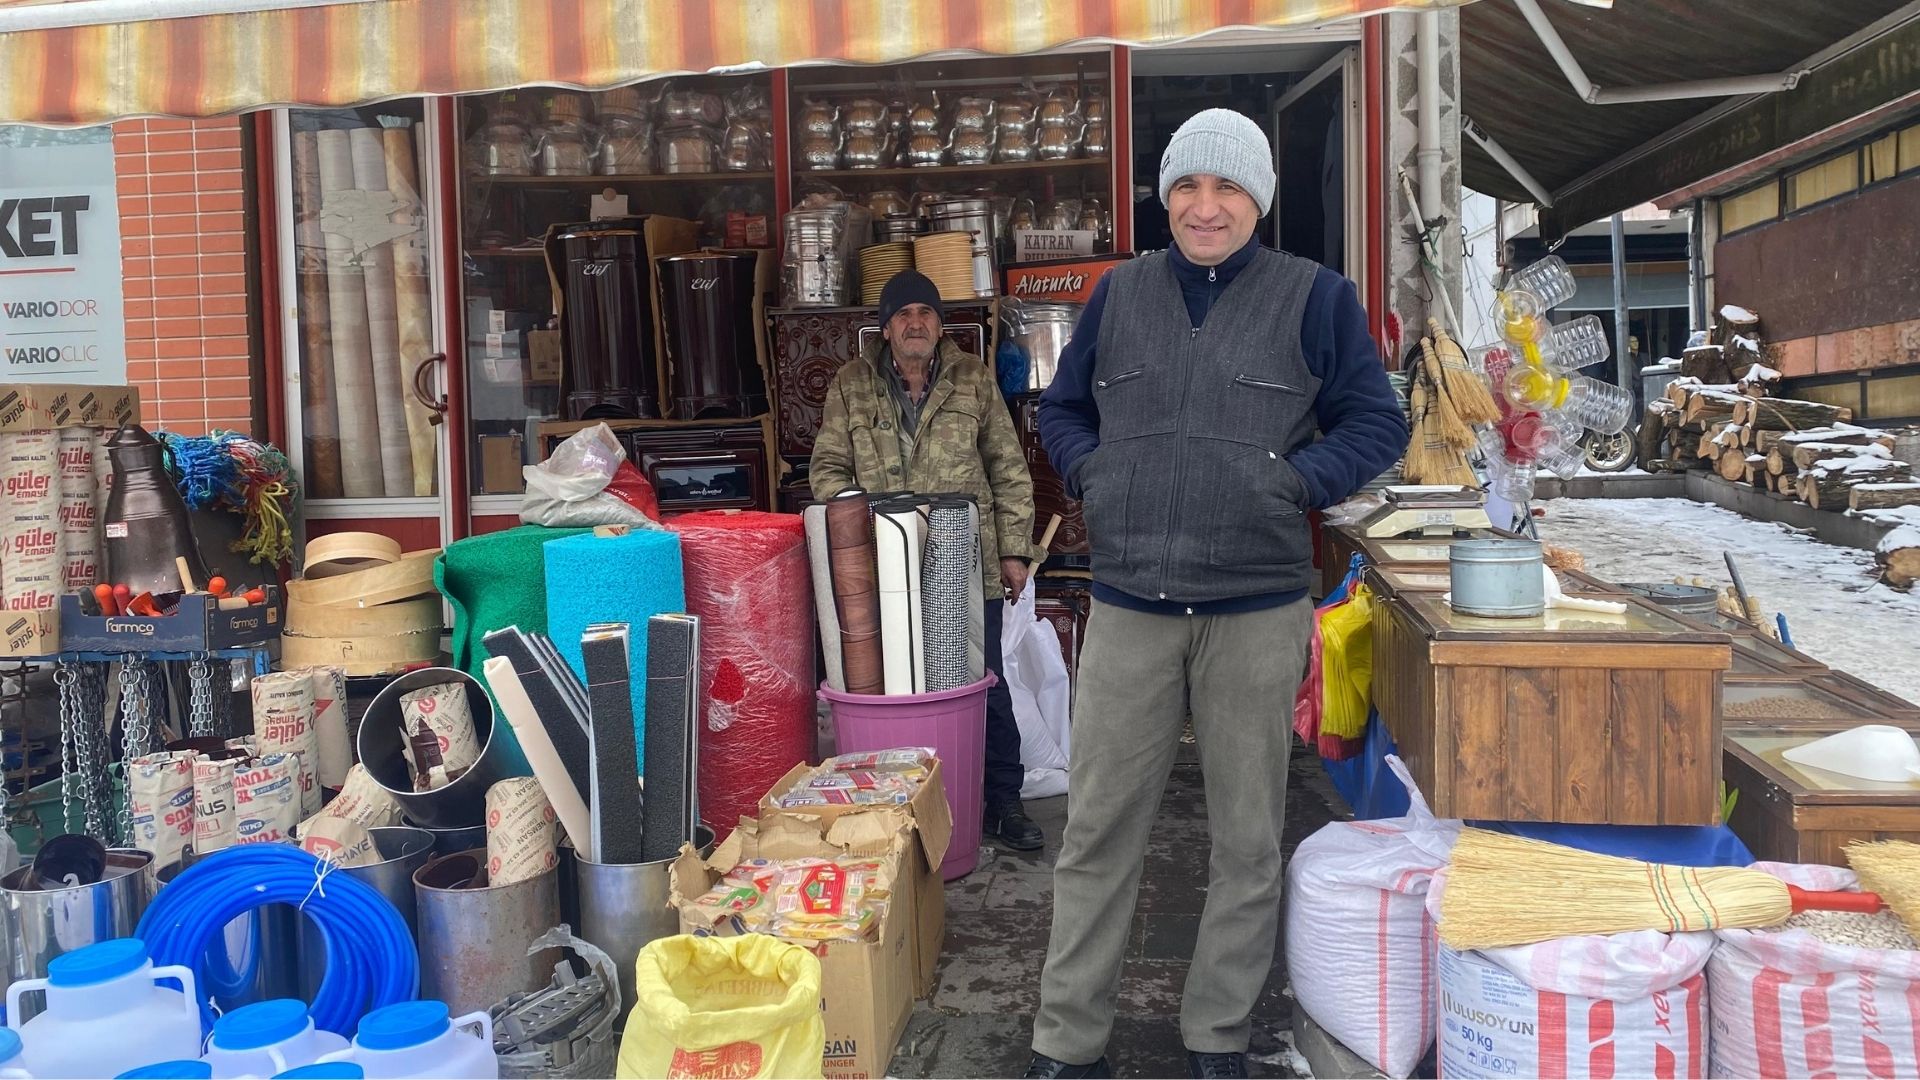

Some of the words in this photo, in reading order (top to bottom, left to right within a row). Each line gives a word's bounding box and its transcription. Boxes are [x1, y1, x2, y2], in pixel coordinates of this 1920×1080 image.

[1024, 235, 1074, 250] KATRAN
[583, 262, 611, 277] Elif
[691, 276, 720, 291] Elif
[1015, 270, 1084, 294] Alaturka
[7, 470, 51, 496] güler
[16, 489, 48, 499] EMAYE
[14, 527, 57, 553] güler
[24, 546, 56, 556] EMAYE
[105, 617, 155, 636] farmco
[229, 616, 259, 629] farmco
[10, 626, 34, 652] güler
[263, 716, 305, 745] güler
[516, 819, 547, 845] NEMSAN
[1453, 1000, 1508, 1031] ULUSOY
[1508, 1021, 1534, 1036] UN
[823, 1040, 856, 1054] SAN
[1461, 1025, 1475, 1042] 50
[1477, 1032, 1493, 1052] kg
